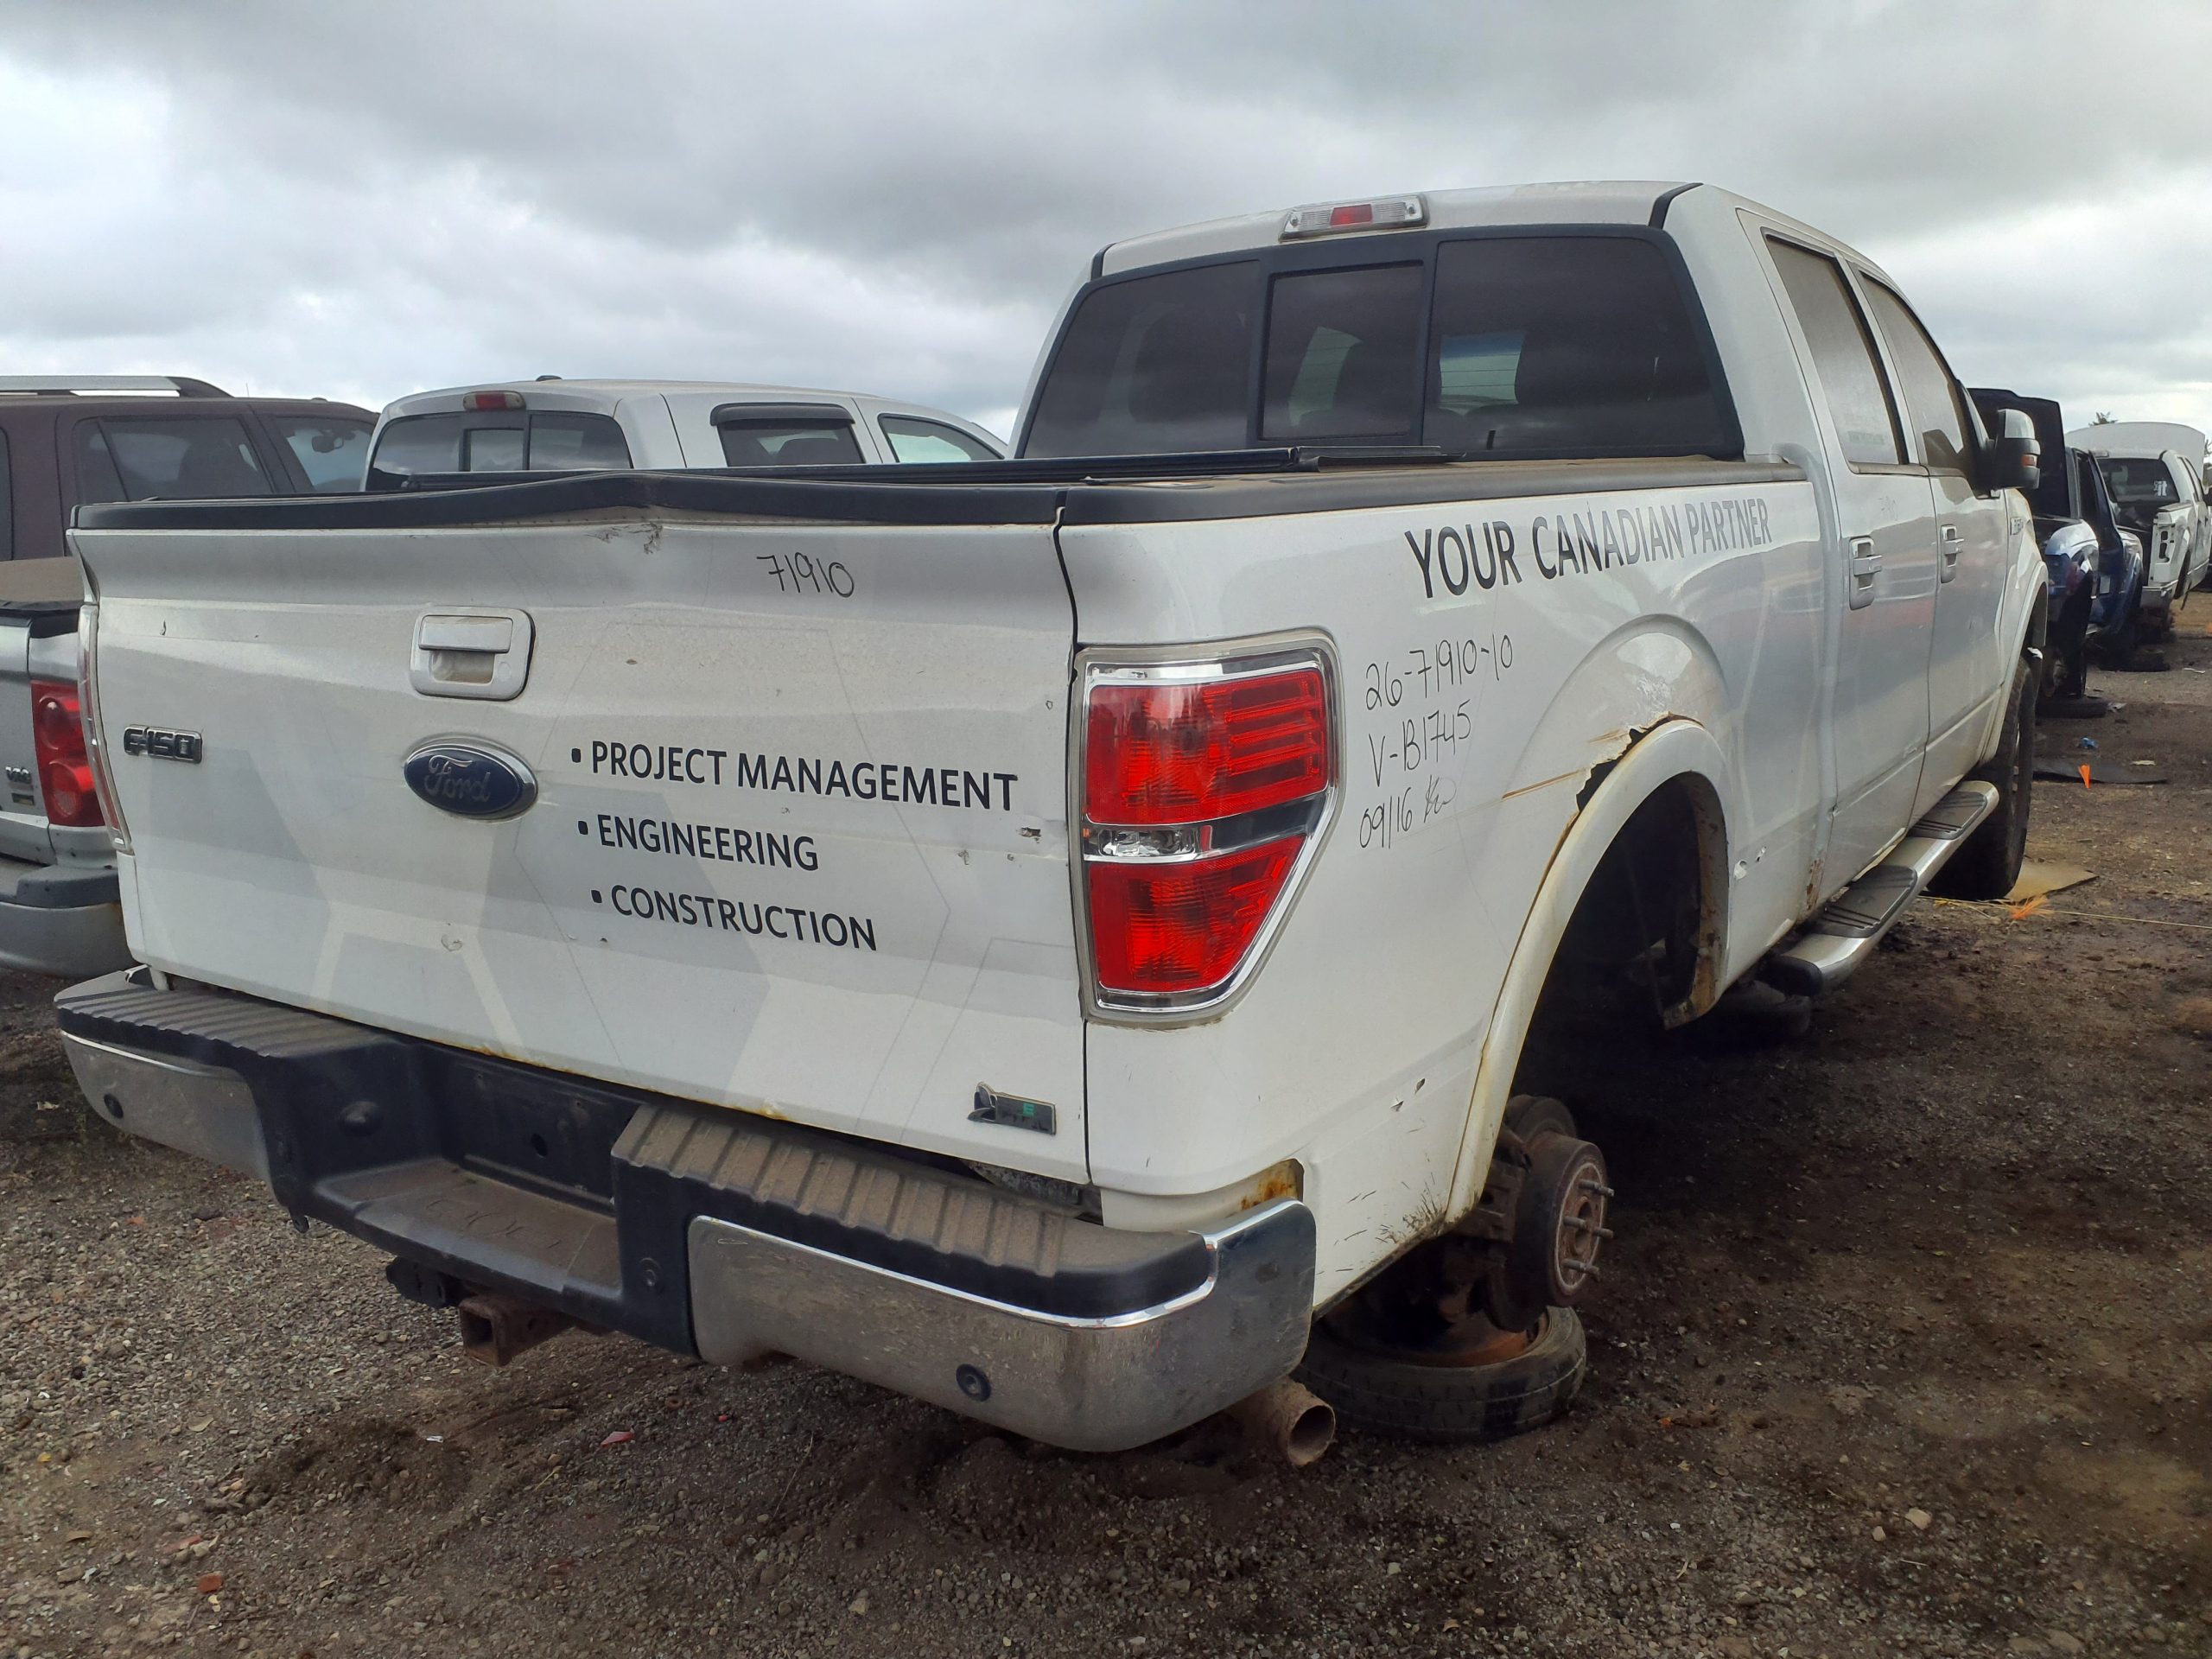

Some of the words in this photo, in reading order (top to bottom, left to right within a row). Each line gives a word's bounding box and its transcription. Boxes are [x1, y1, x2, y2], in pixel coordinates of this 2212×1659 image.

[756, 551, 855, 598] 71910
[1404, 520, 1523, 599] YOUR
[1531, 504, 1686, 580] CANADIAN
[1685, 497, 1774, 555] PARTNER
[1365, 632, 1514, 711] 26-71910-10
[423, 753, 492, 803] Ford
[592, 740, 728, 785] PROJECT
[738, 753, 1019, 811] MANAGEMENT
[597, 814, 819, 871] ENGINEERING
[611, 884, 877, 951] CONSTRUCTION
